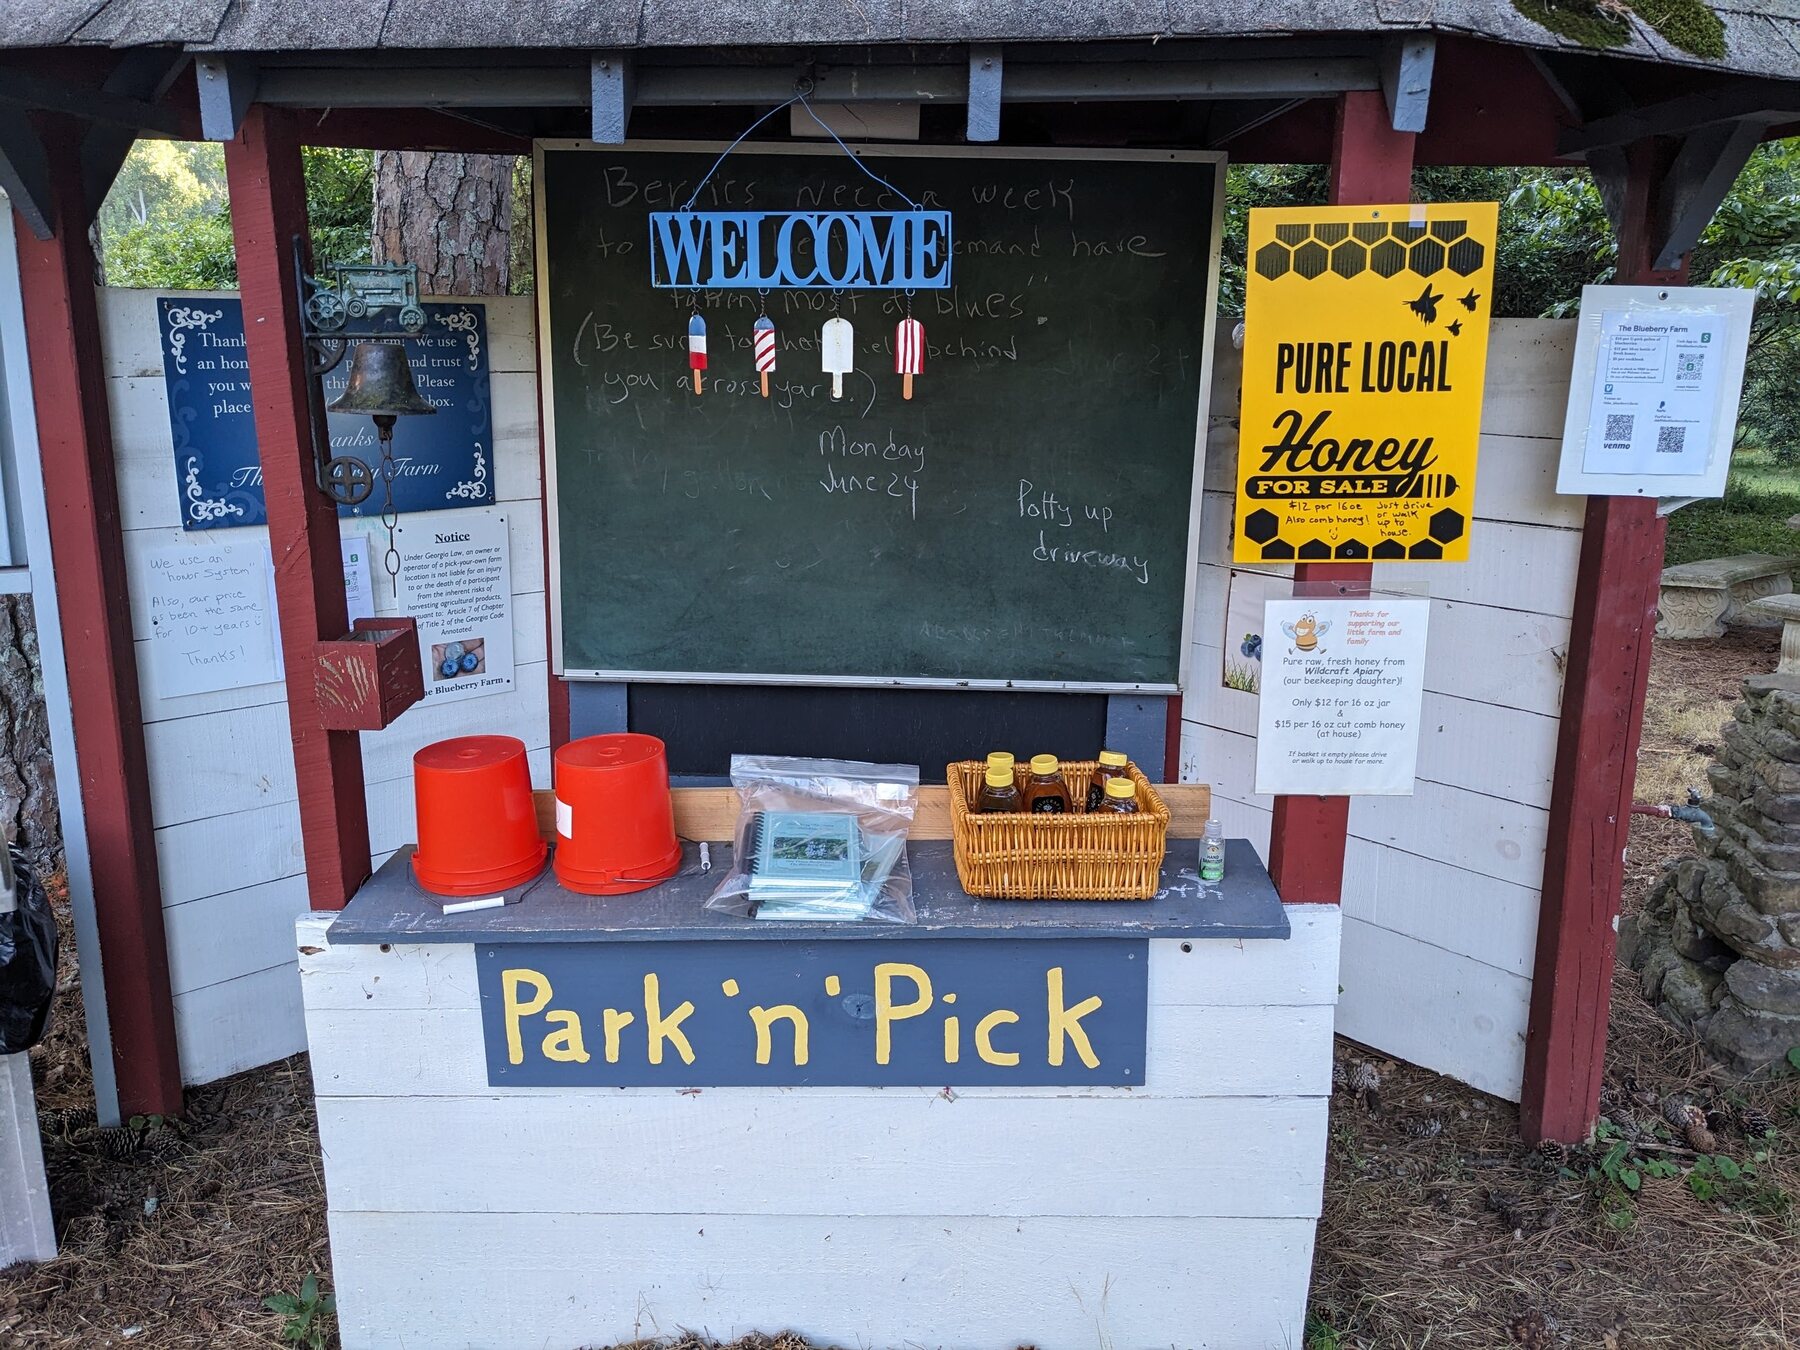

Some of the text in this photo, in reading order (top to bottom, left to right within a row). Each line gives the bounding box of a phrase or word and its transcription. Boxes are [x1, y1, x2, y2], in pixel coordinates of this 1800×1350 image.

[655, 213, 947, 286] WELCOME
[1633, 325, 1668, 334] Blueberry
[1670, 325, 1689, 333] Farm
[416, 335, 434, 347] We
[438, 338, 457, 347] use
[197, 358, 462, 370] an trust
[1275, 340, 1452, 394] PURE LOCAL
[208, 382, 235, 396] you
[417, 374, 455, 388] Please
[604, 371, 659, 404] you
[213, 399, 251, 418] place
[818, 428, 926, 473] Monday
[1258, 409, 1439, 492] Honey
[391, 457, 442, 480] Farm
[1256, 479, 1388, 496] FOR SALE
[1017, 479, 1113, 533] Potty up
[1289, 501, 1311, 512] $12
[1403, 501, 1434, 509] drive
[1285, 516, 1306, 525] Also
[1309, 516, 1333, 525] comb
[1377, 518, 1405, 527] up to
[434, 531, 471, 544] Notice
[404, 553, 424, 562] Under
[424, 550, 450, 560] Georgia
[475, 547, 493, 555] owner
[1033, 531, 1150, 583] driveway
[150, 555, 223, 569] We use an
[403, 563, 430, 573] operator
[404, 571, 430, 582] location
[437, 570, 448, 578] not
[449, 568, 466, 577] liable
[486, 563, 503, 574] injury
[215, 591, 247, 606] price
[204, 607, 225, 615] the
[1349, 610, 1390, 619] Thanks for
[155, 627, 174, 639] for
[213, 620, 250, 636] years
[1347, 620, 1386, 629] supporting
[1346, 628, 1402, 637] little farm and
[1346, 638, 1370, 647] family
[1283, 657, 1303, 666] Pure
[1326, 657, 1352, 666] fresh
[1354, 657, 1381, 669] honey
[1383, 657, 1406, 666] from
[1304, 666, 1384, 678] Wildcraft Apiary
[435, 681, 480, 695] Blueberry
[480, 677, 504, 687] Farm
[1283, 676, 1302, 686] (our
[1304, 675, 1354, 688] beekeeping
[1291, 698, 1313, 709] Only
[1314, 697, 1332, 708] $12
[1334, 697, 1350, 707] for
[1351, 698, 1361, 707] 16
[1377, 698, 1391, 710] jar
[1336, 710, 1344, 718] &
[1274, 719, 1292, 729] $15
[1293, 721, 1310, 731] per
[1311, 719, 1322, 729] 16
[1336, 720, 1352, 729] cut
[1353, 719, 1377, 729] comb
[1379, 719, 1406, 732] honey
[1316, 729, 1362, 739] (at house)
[1288, 749, 1297, 758] If
[1297, 749, 1320, 758] basket
[1327, 751, 1348, 760] empty
[1349, 749, 1370, 760] please
[1371, 749, 1388, 758] drive
[1300, 756, 1316, 764] walk
[1316, 758, 1325, 766] up
[1334, 756, 1353, 764] house
[1354, 756, 1366, 767] for
[501, 968, 695, 1065] Park
[874, 963, 1103, 1069] Pick
